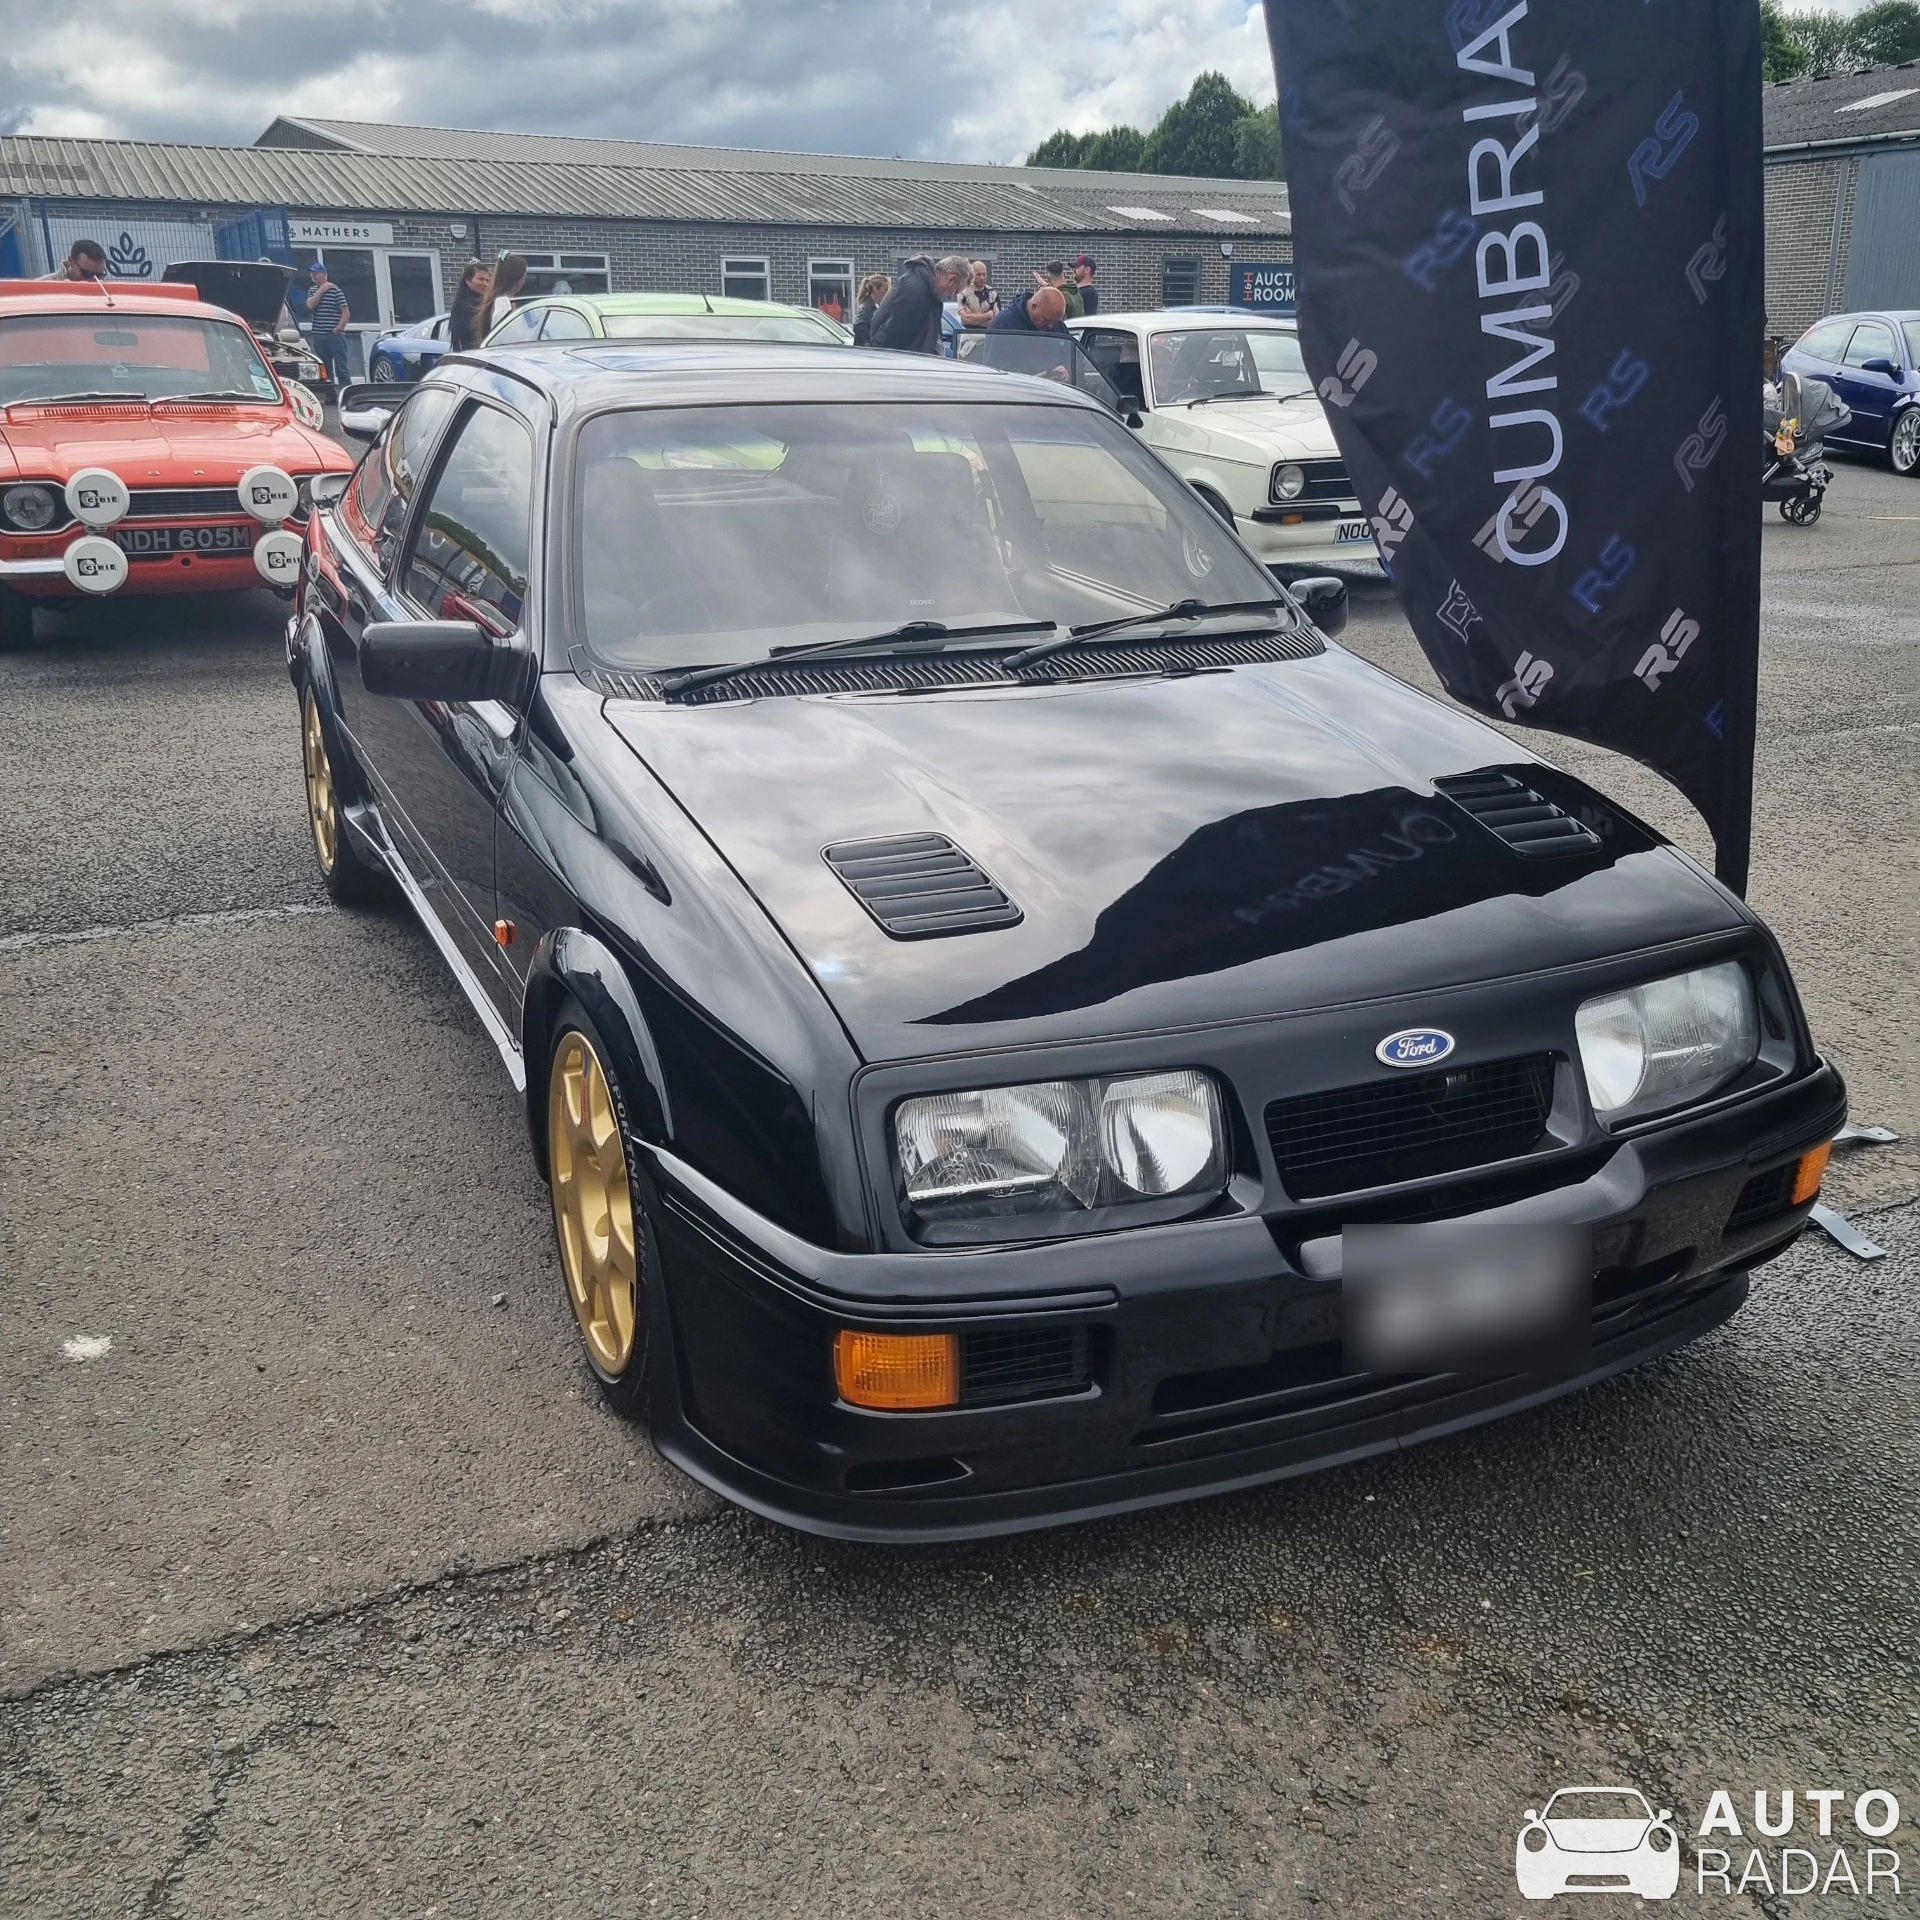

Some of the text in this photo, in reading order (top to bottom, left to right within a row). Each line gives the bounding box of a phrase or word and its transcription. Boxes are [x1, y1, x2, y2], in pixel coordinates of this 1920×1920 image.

[1333, 113, 1400, 215] RS
[1627, 89, 1699, 208] RS
[302, 226, 370, 238] MATHERS
[1402, 209, 1477, 293] RS
[1456, 0, 1568, 566] CUMBRIA
[1318, 336, 1378, 408] RS
[1578, 346, 1650, 433] RS
[1402, 397, 1472, 479] RS
[1674, 393, 1728, 493] RS
[114, 527, 250, 550] NDH 605M
[1370, 485, 1415, 563] RS
[1570, 533, 1637, 614] RS
[1495, 650, 1554, 719] RS
[1634, 607, 1700, 693] RS
[1397, 1035, 1437, 1059] Ford
